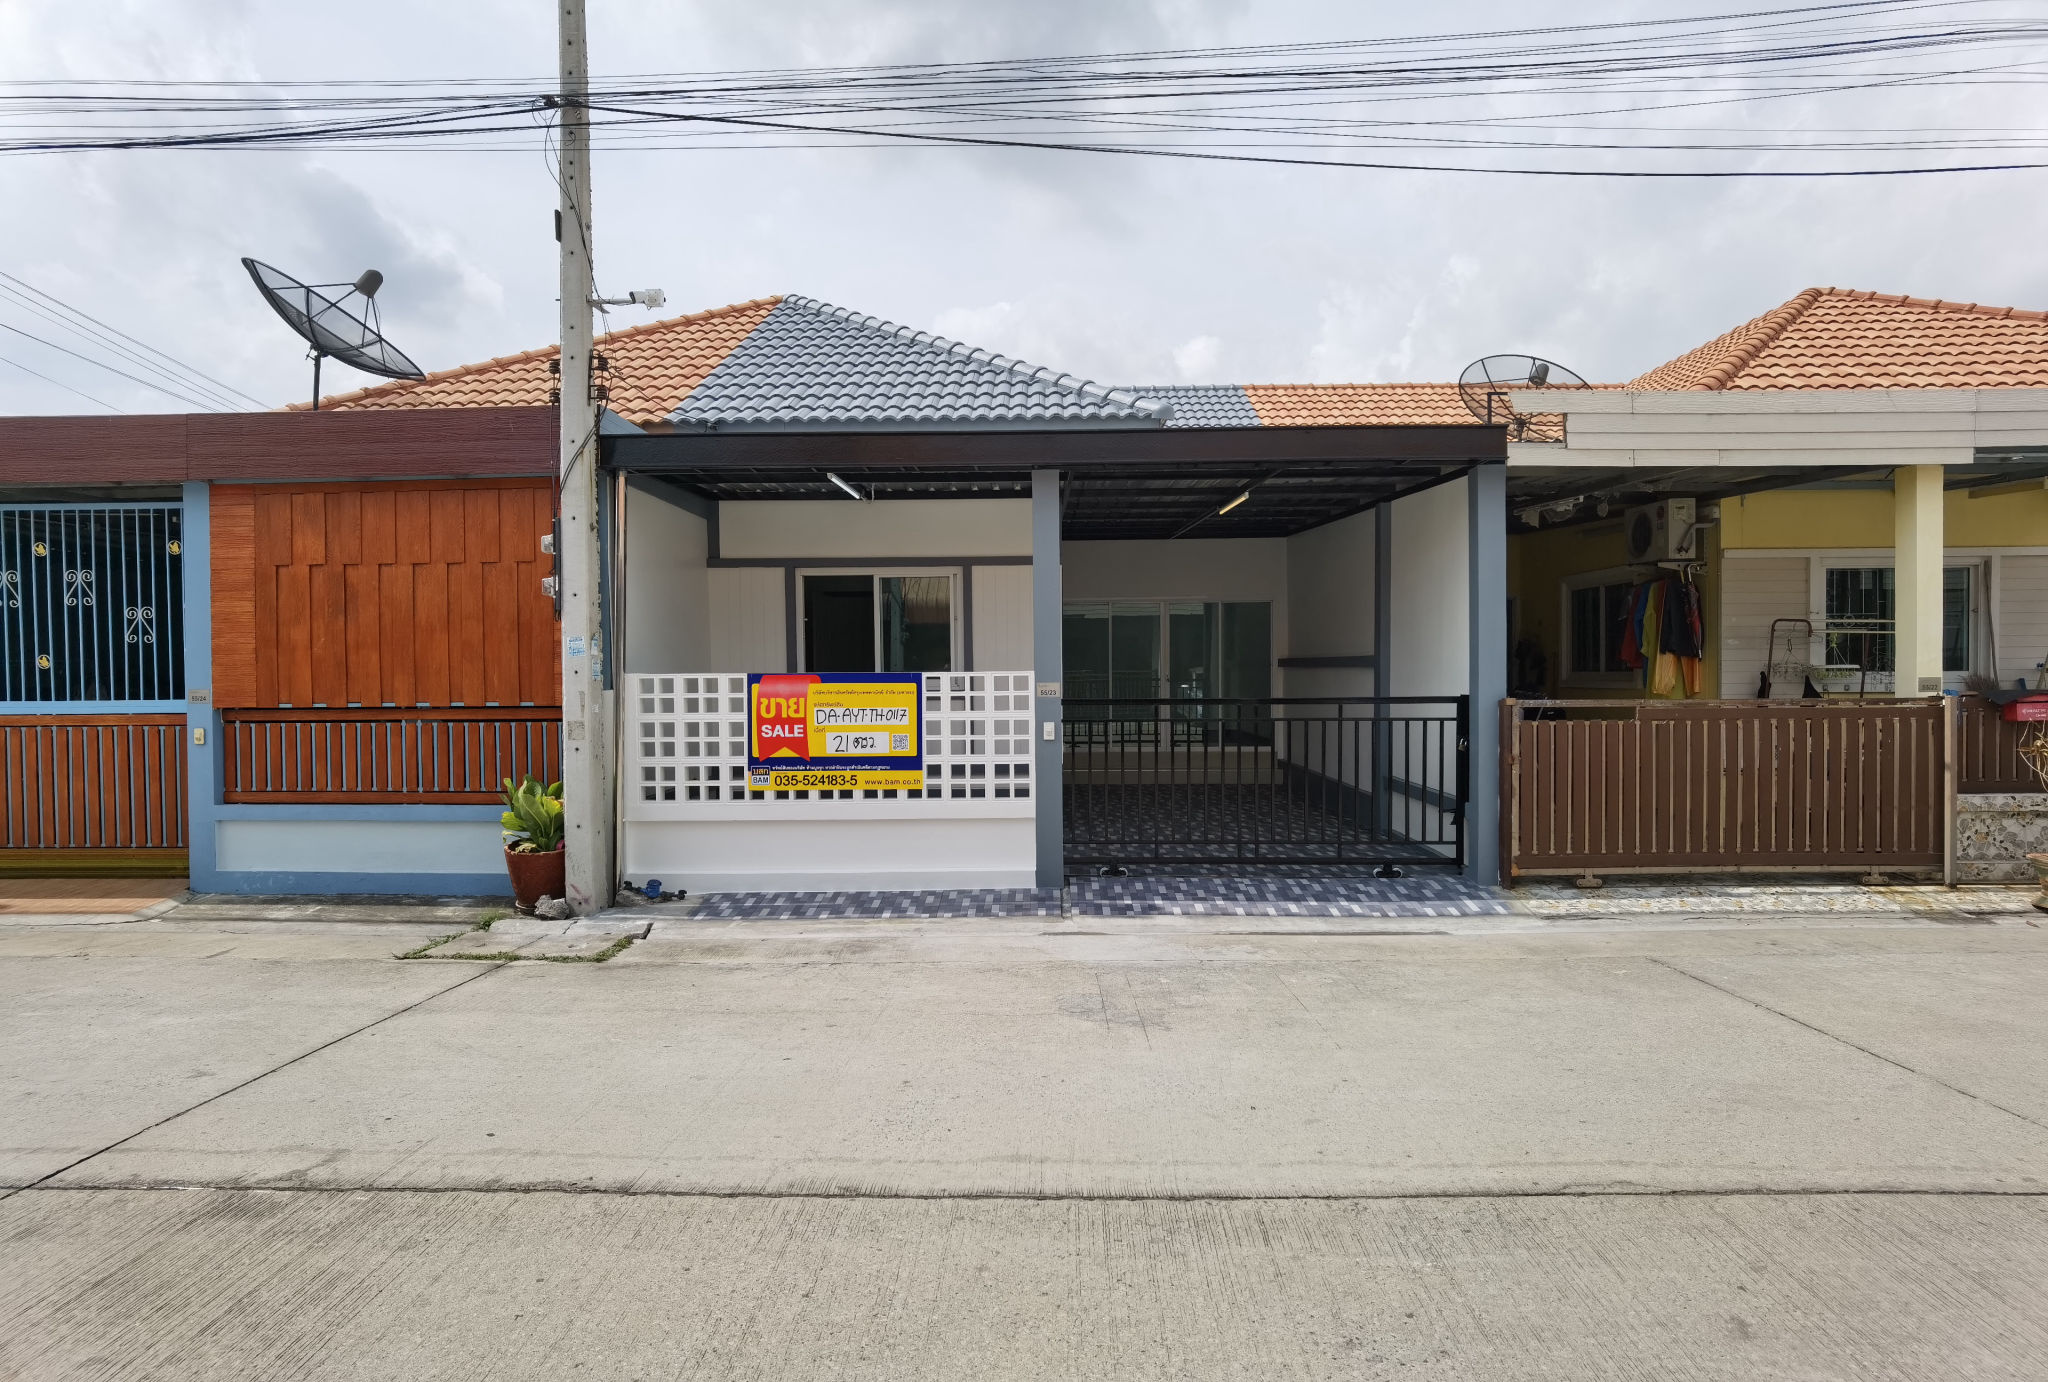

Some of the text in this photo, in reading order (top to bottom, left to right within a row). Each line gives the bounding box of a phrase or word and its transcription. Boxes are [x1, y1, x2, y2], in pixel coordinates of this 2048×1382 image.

[760, 697, 805, 718] ขาย
[761, 724, 804, 738] SALE
[833, 734, 849, 752] 21
[752, 776, 769, 784] BAM
[774, 775, 858, 786] 035-524183-5
